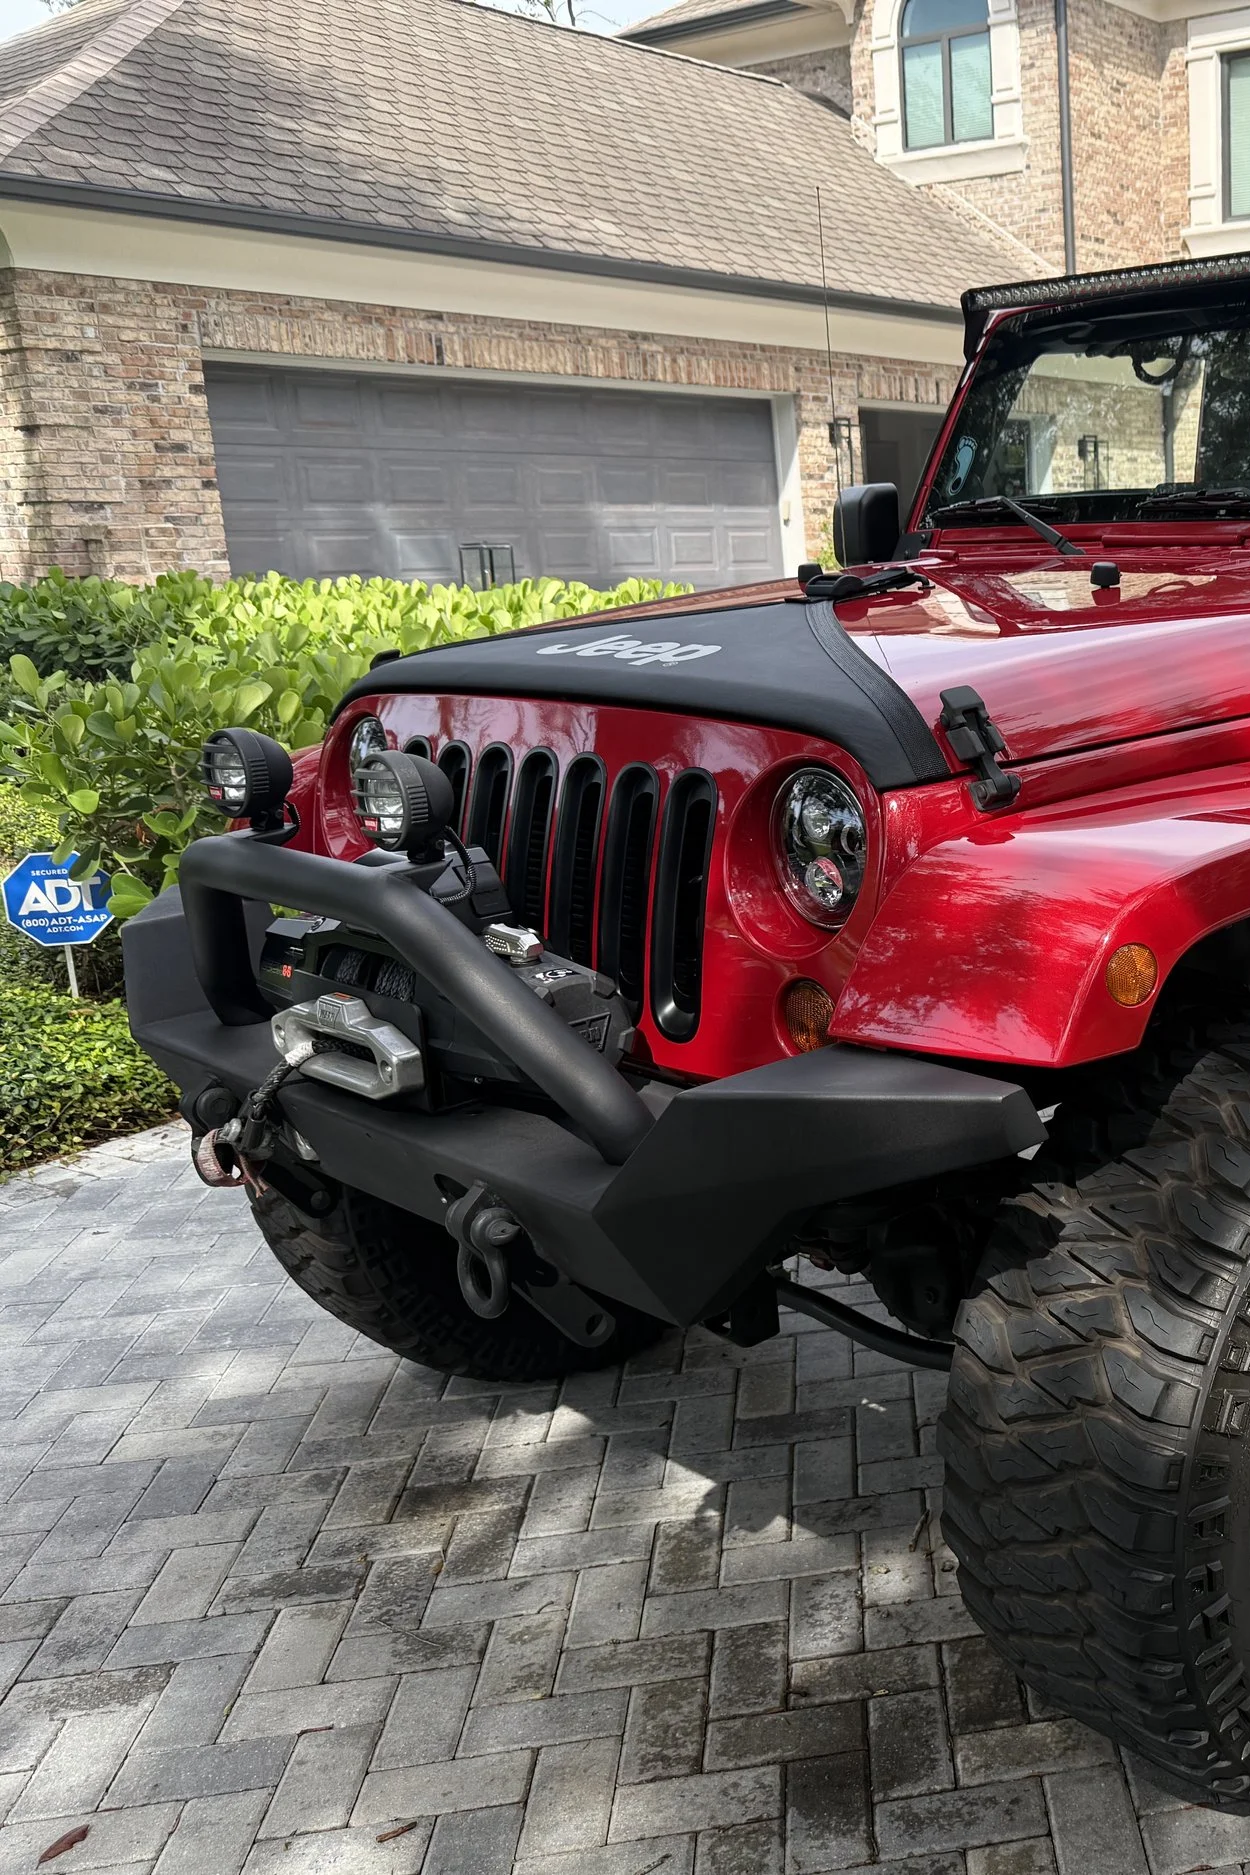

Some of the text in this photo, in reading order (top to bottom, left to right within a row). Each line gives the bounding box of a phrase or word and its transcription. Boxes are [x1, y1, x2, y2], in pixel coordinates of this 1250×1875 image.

[536, 634, 722, 666] Jeep
[31, 868, 68, 877] SECURED
[18, 876, 101, 916] ADT
[22, 913, 108, 929] (800) ADT-ASAP
[46, 925, 84, 933] ADT.COM
